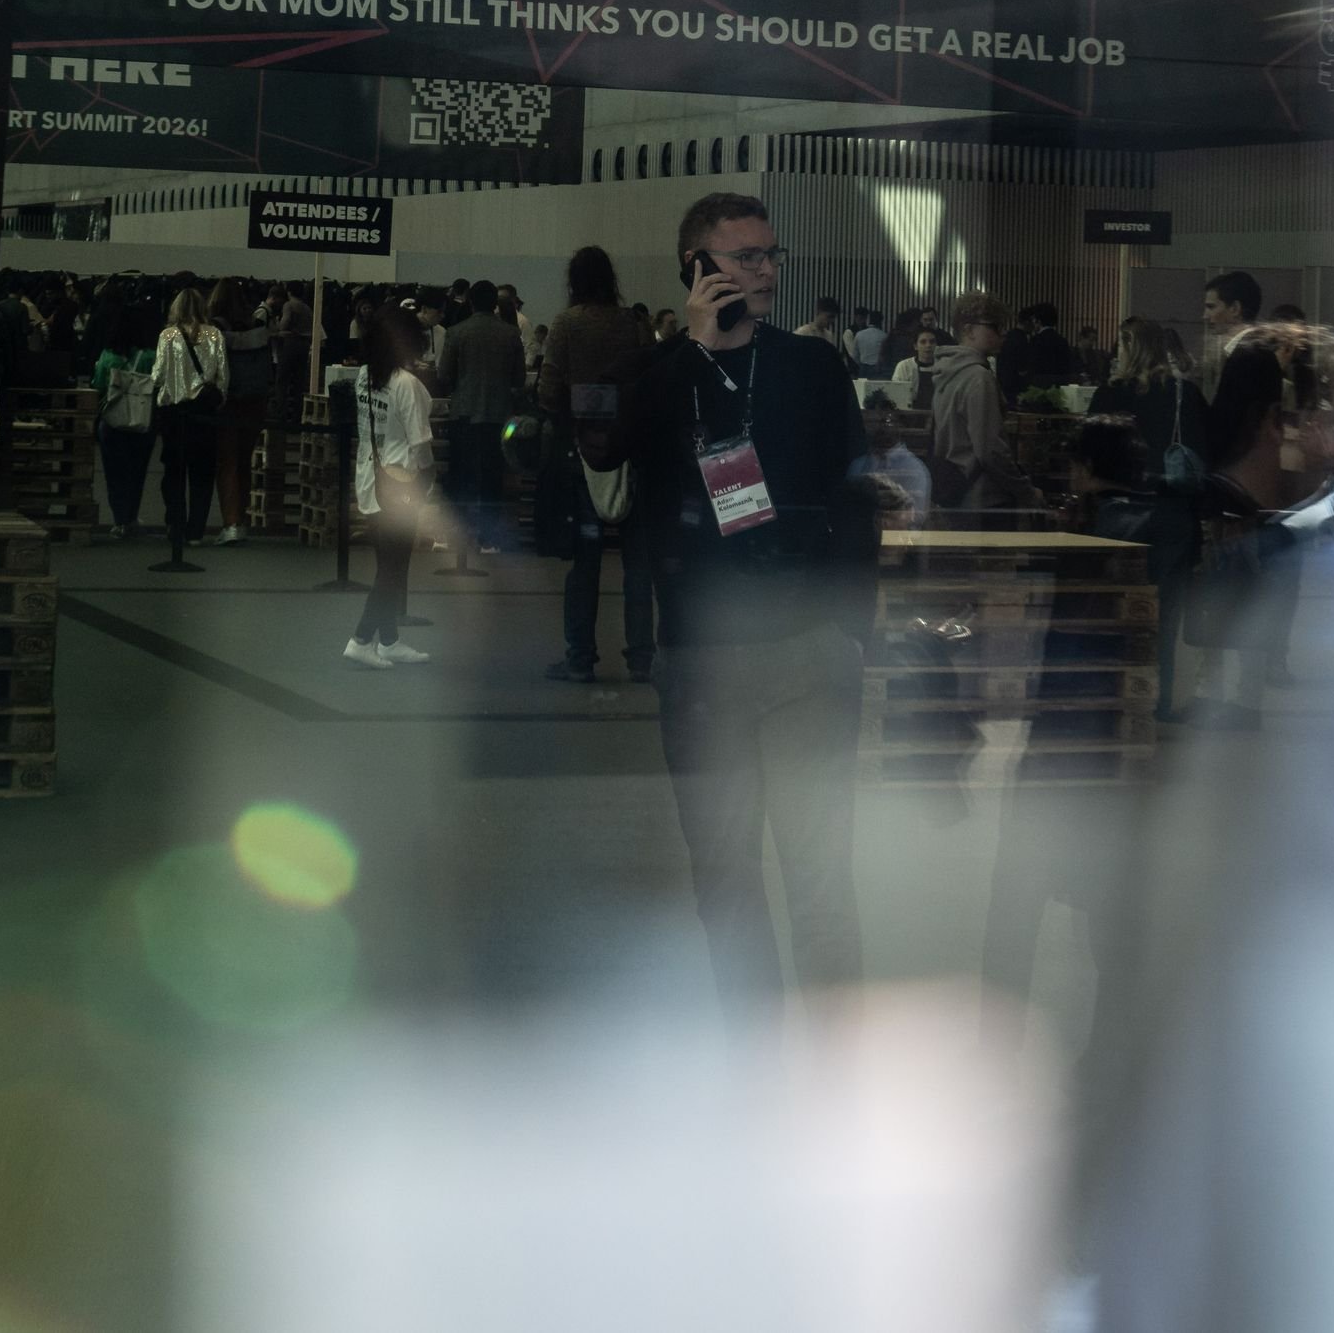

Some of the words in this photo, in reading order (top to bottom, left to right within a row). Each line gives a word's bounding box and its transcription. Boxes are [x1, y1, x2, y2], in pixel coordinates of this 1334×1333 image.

[488, 0, 619, 34] THINKS
[629, 8, 704, 39] YOU
[715, 14, 858, 48] SHOULD
[868, 24, 933, 53] GET
[939, 29, 963, 55] A
[972, 31, 1053, 61] REAL
[1060, 37, 1125, 65] JOB
[42, 112, 137, 132] SUMMIT
[143, 116, 207, 136] 2026!
[262, 202, 367, 221] ATTENDEES
[260, 223, 380, 243] VOLUNTEERS
[1104, 223, 1151, 231] INVESTOR
[713, 482, 742, 496] TALENT
